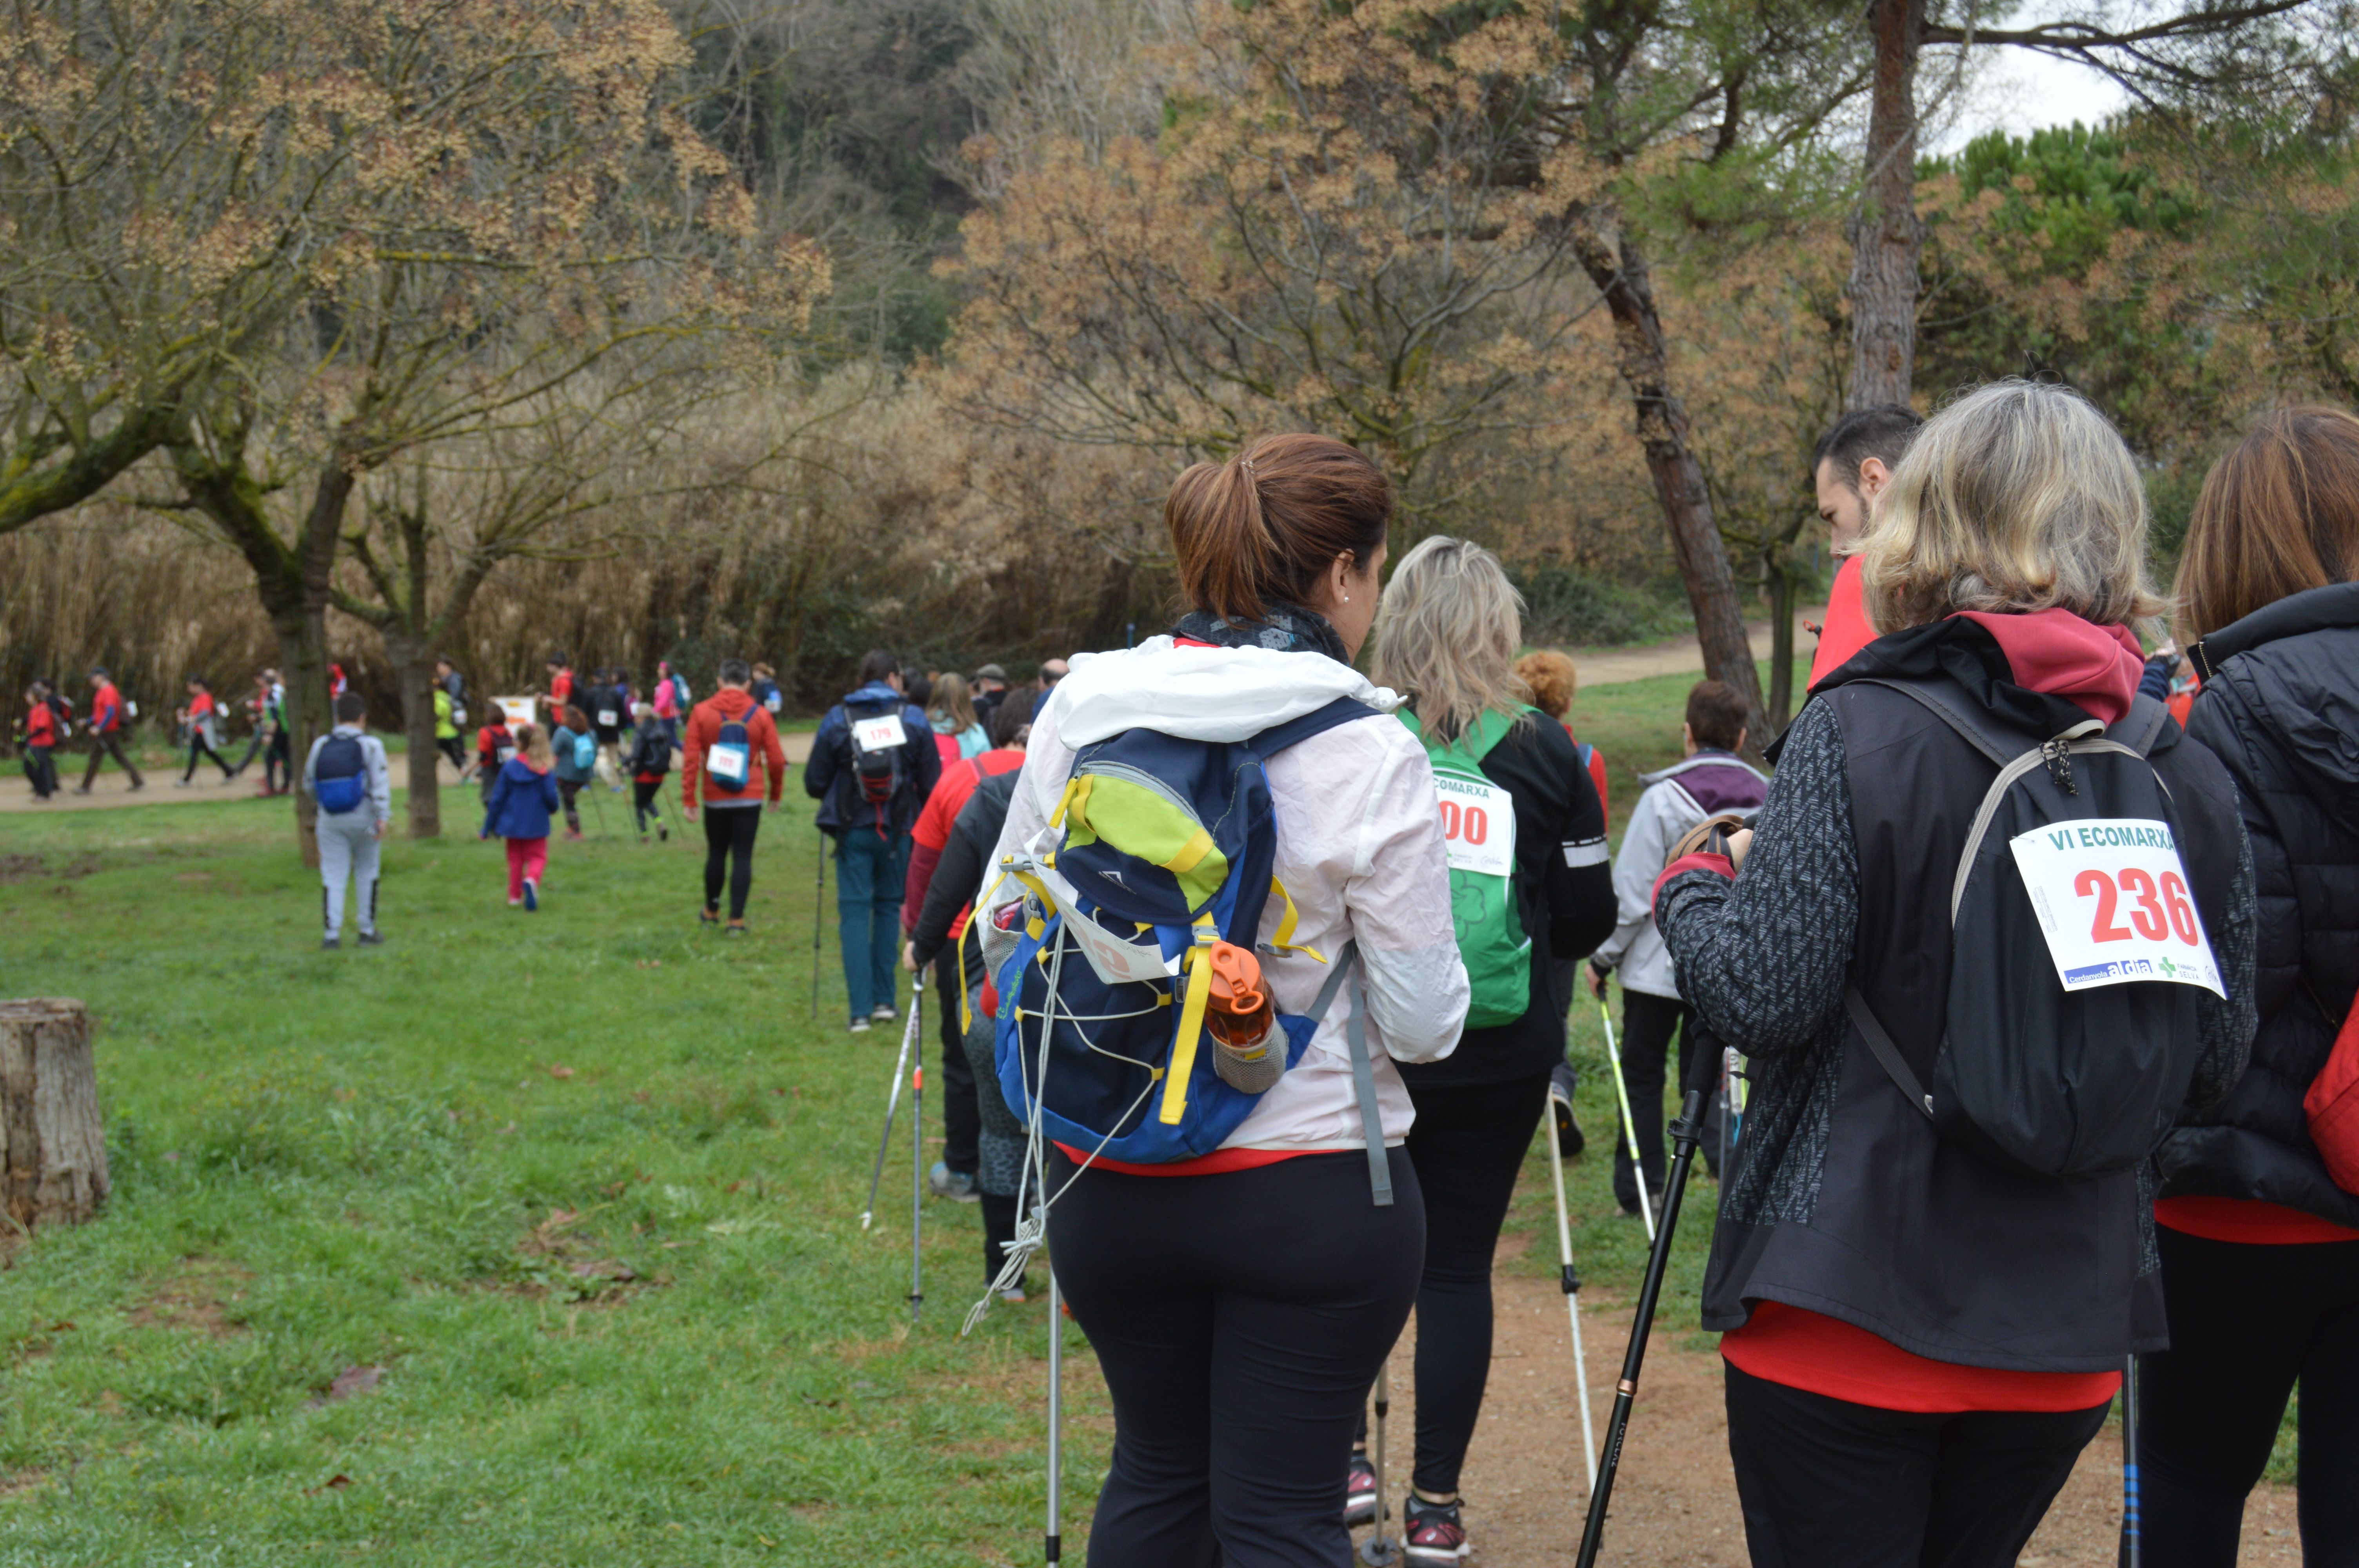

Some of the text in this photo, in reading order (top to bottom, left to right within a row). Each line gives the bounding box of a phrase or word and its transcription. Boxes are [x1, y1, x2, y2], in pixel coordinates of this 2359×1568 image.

[2047, 827, 2176, 853] VI ECOMARXA
[2074, 867, 2199, 947] 236
[2069, 971, 2108, 983] Cerdanyola
[2179, 970, 2200, 980] SELVA
